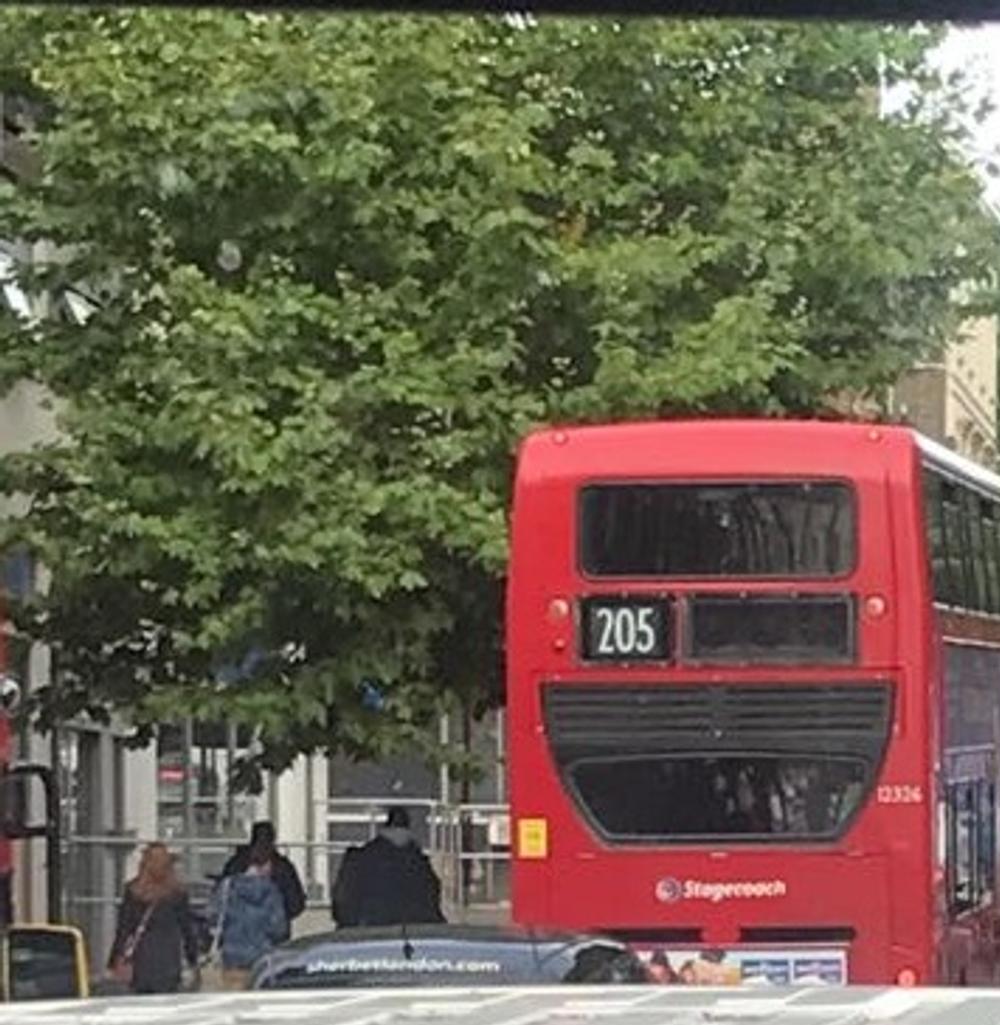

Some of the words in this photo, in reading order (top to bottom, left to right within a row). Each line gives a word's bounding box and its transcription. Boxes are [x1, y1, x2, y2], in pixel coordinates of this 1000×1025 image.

[596, 607, 655, 653] 205
[683, 879, 786, 902] Stagecoach
[306, 958, 500, 974] sherbetlondon.com
